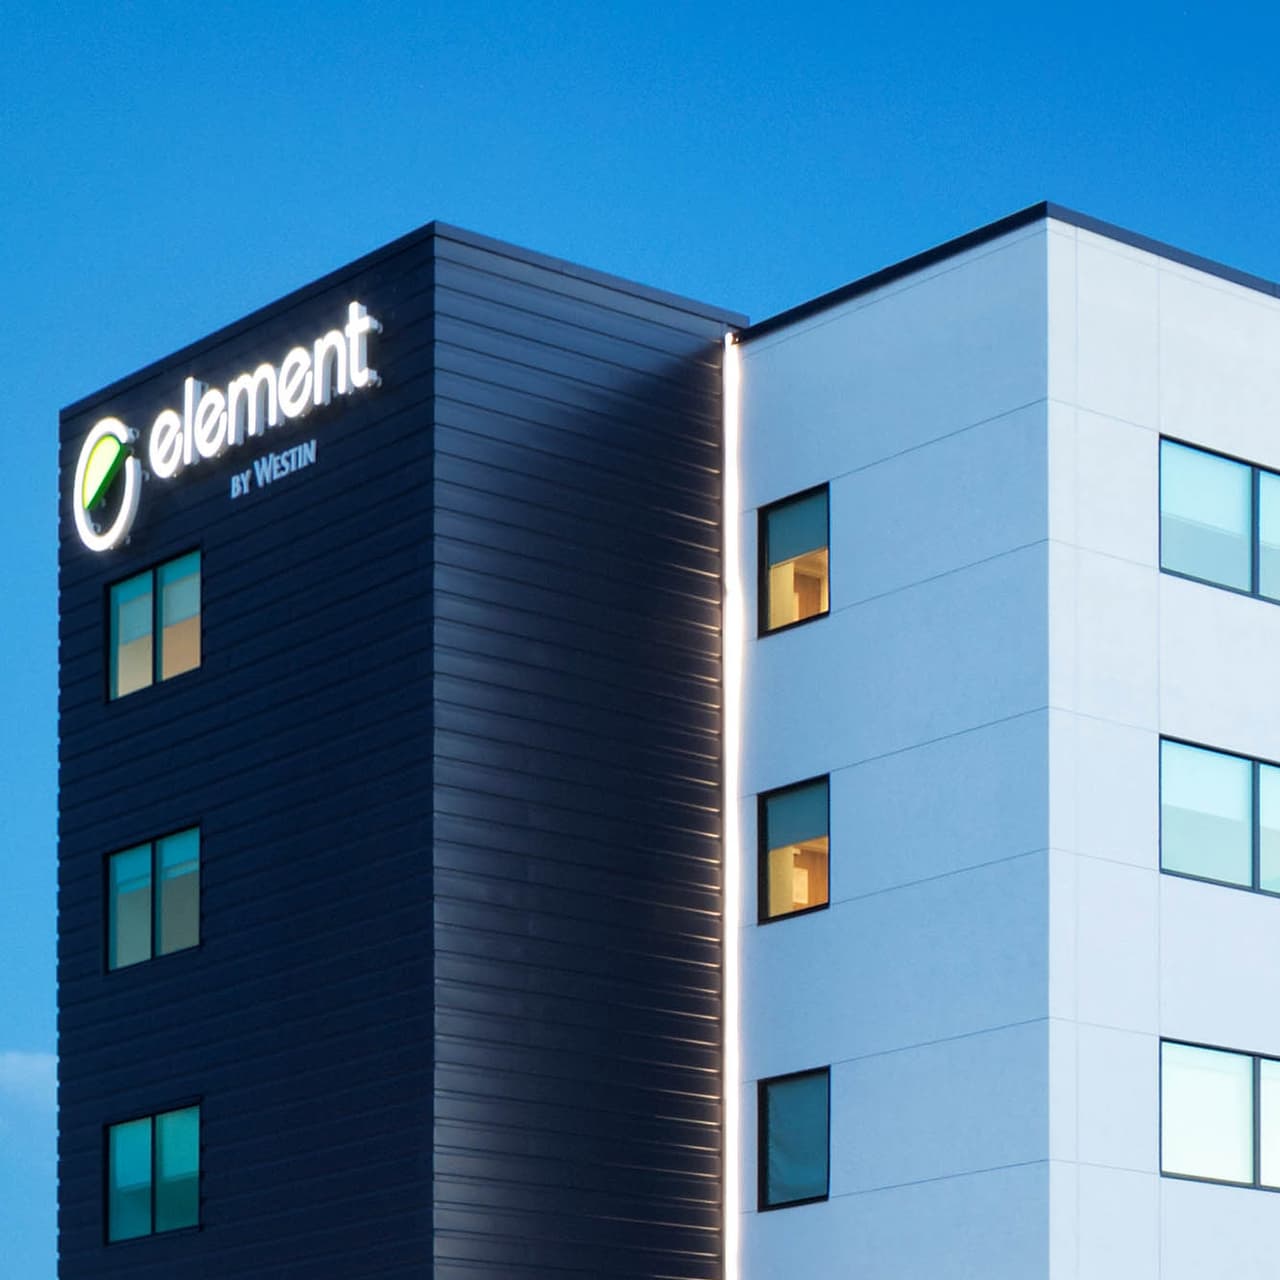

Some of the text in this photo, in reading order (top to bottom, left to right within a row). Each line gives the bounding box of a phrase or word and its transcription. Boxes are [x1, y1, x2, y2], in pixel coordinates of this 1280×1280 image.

[149, 300, 382, 479] element
[231, 439, 317, 499] BY WESTIN
